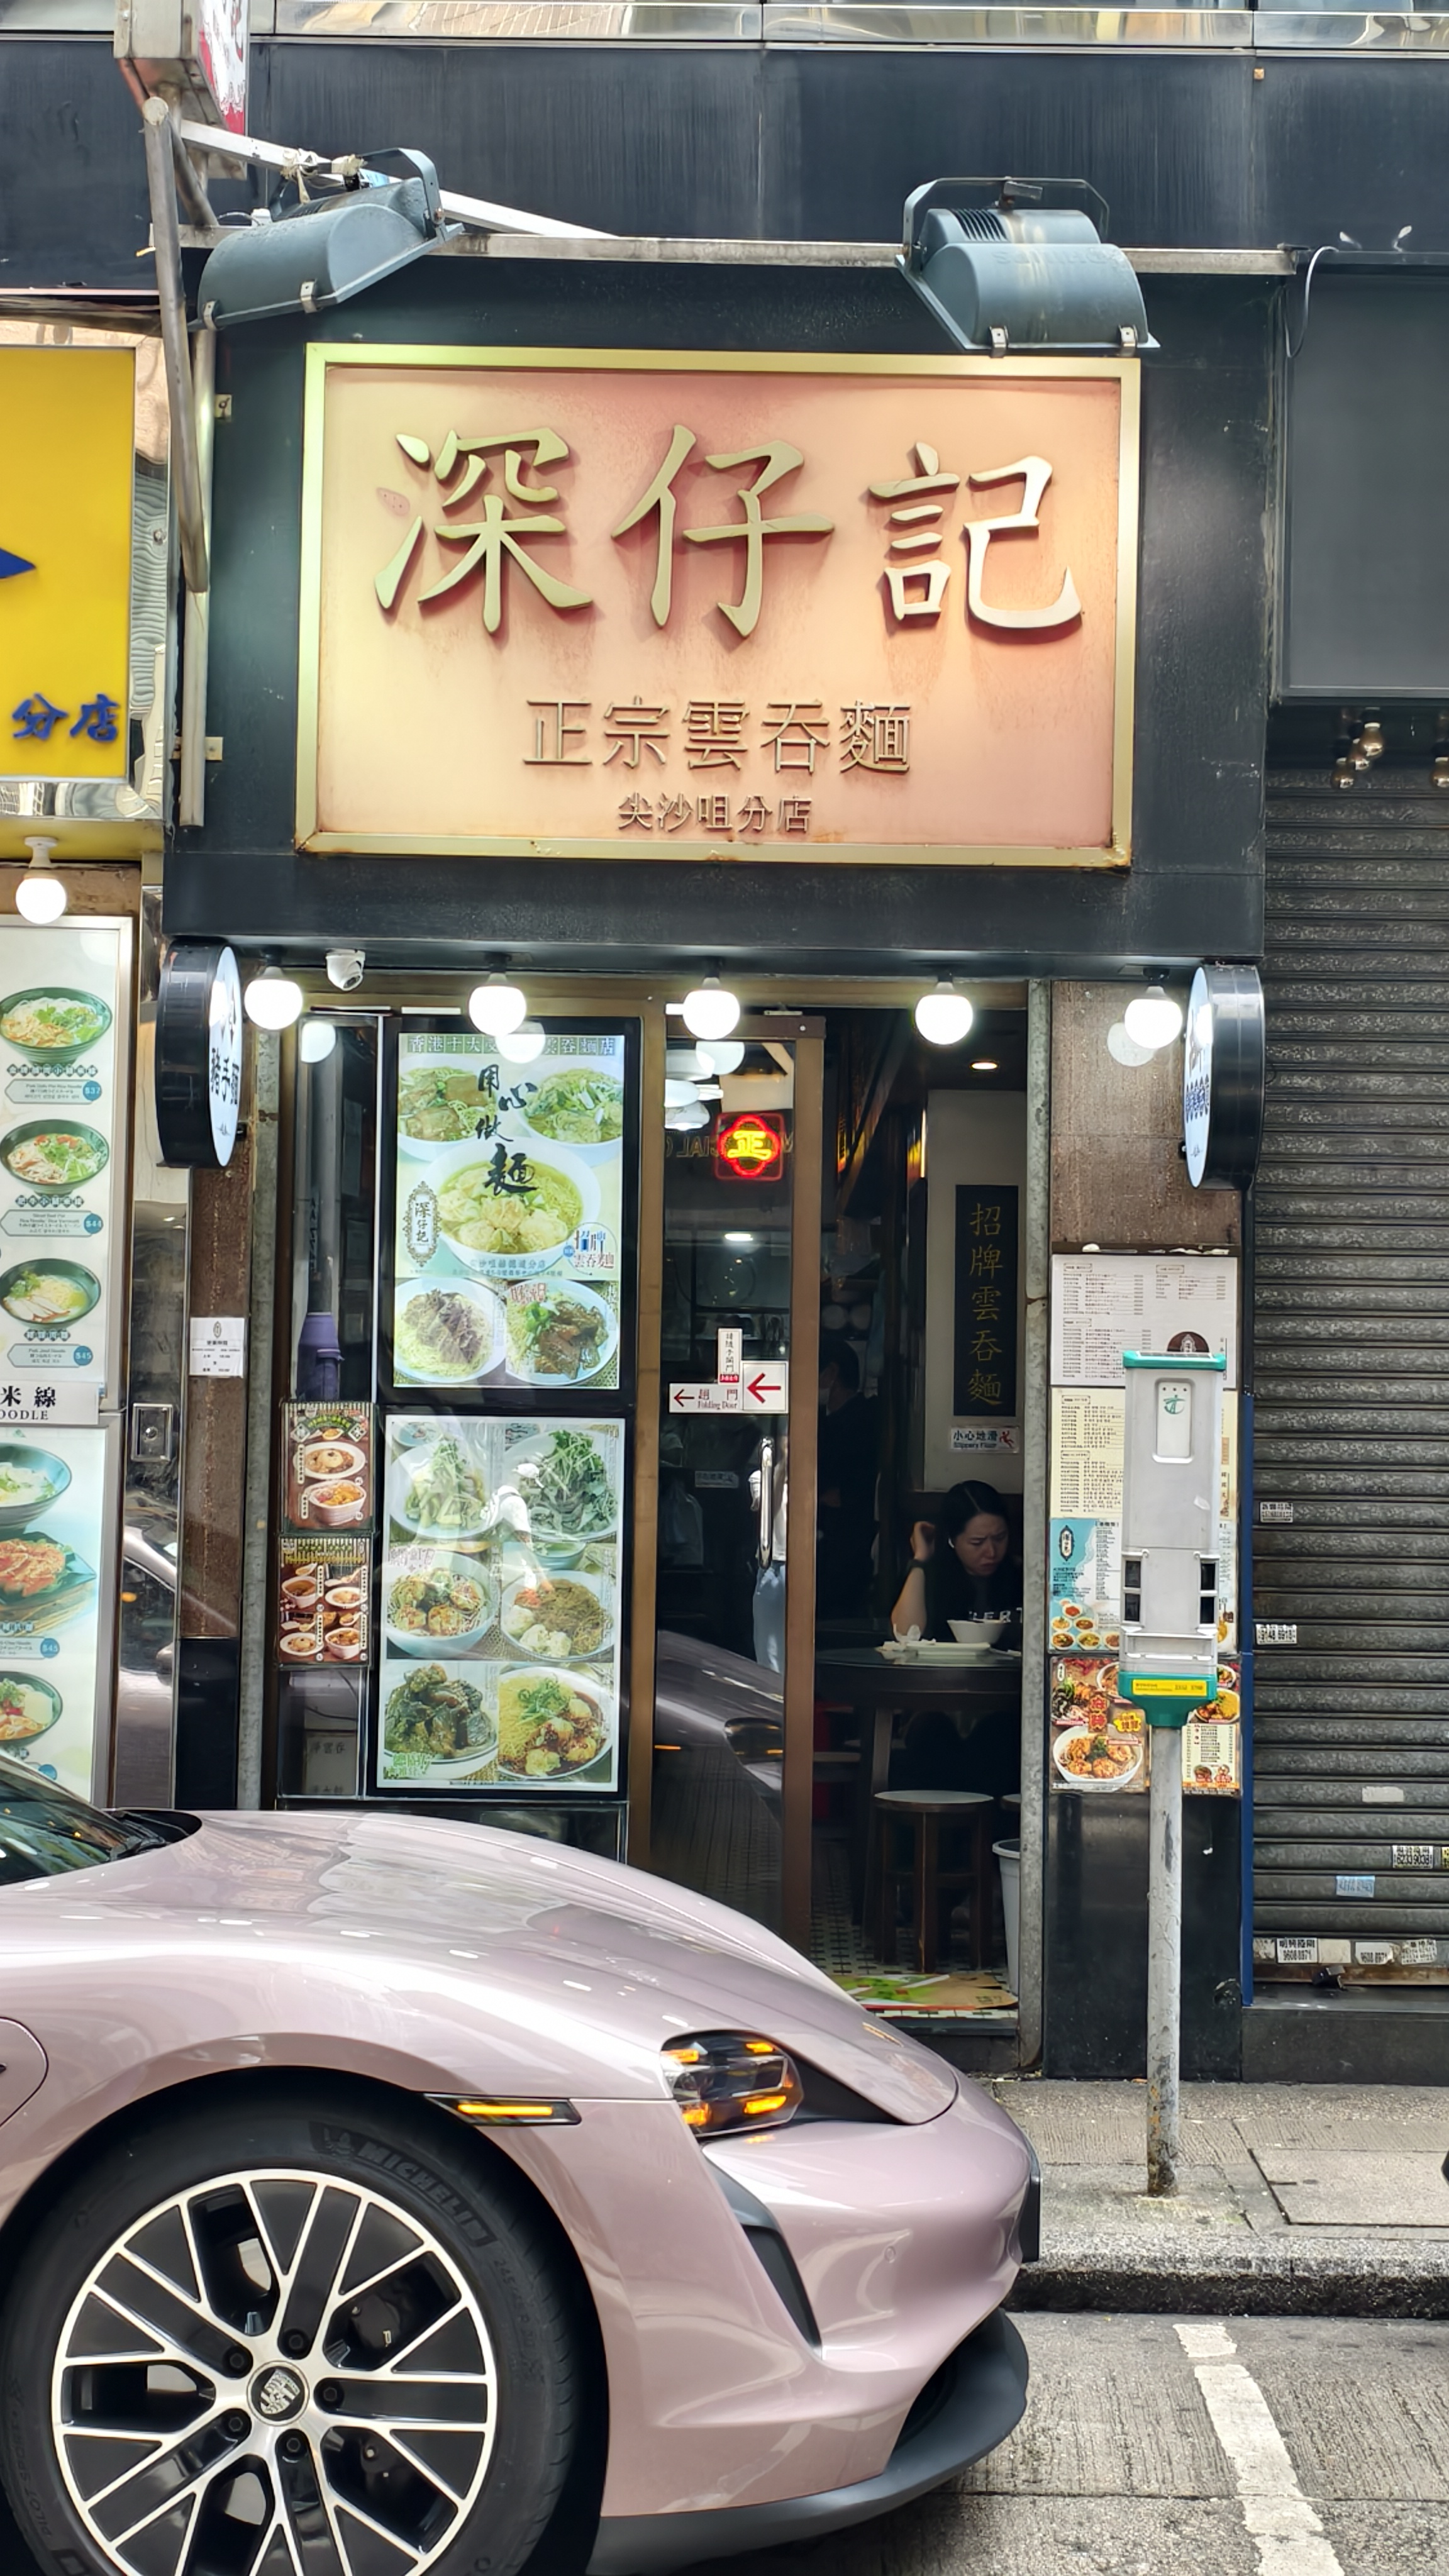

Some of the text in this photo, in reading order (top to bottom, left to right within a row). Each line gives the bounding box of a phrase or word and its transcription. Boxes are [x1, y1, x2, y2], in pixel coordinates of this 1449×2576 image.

[374, 425, 1082, 637] 深仔記
[13, 693, 119, 741] 分店
[523, 696, 911, 774] 正宗雲吞麵
[618, 792, 813, 832] 尖沙咀分店
[475, 1064, 538, 1196] 用心做麵
[728, 1130, 772, 1161] 正
[969, 1202, 1003, 1406] 招牌雲吞麵
[0, 1385, 56, 1407] 米線
[953, 1430, 997, 1441] 小心地滑
[357, 2140, 491, 2245] MICHELIN
